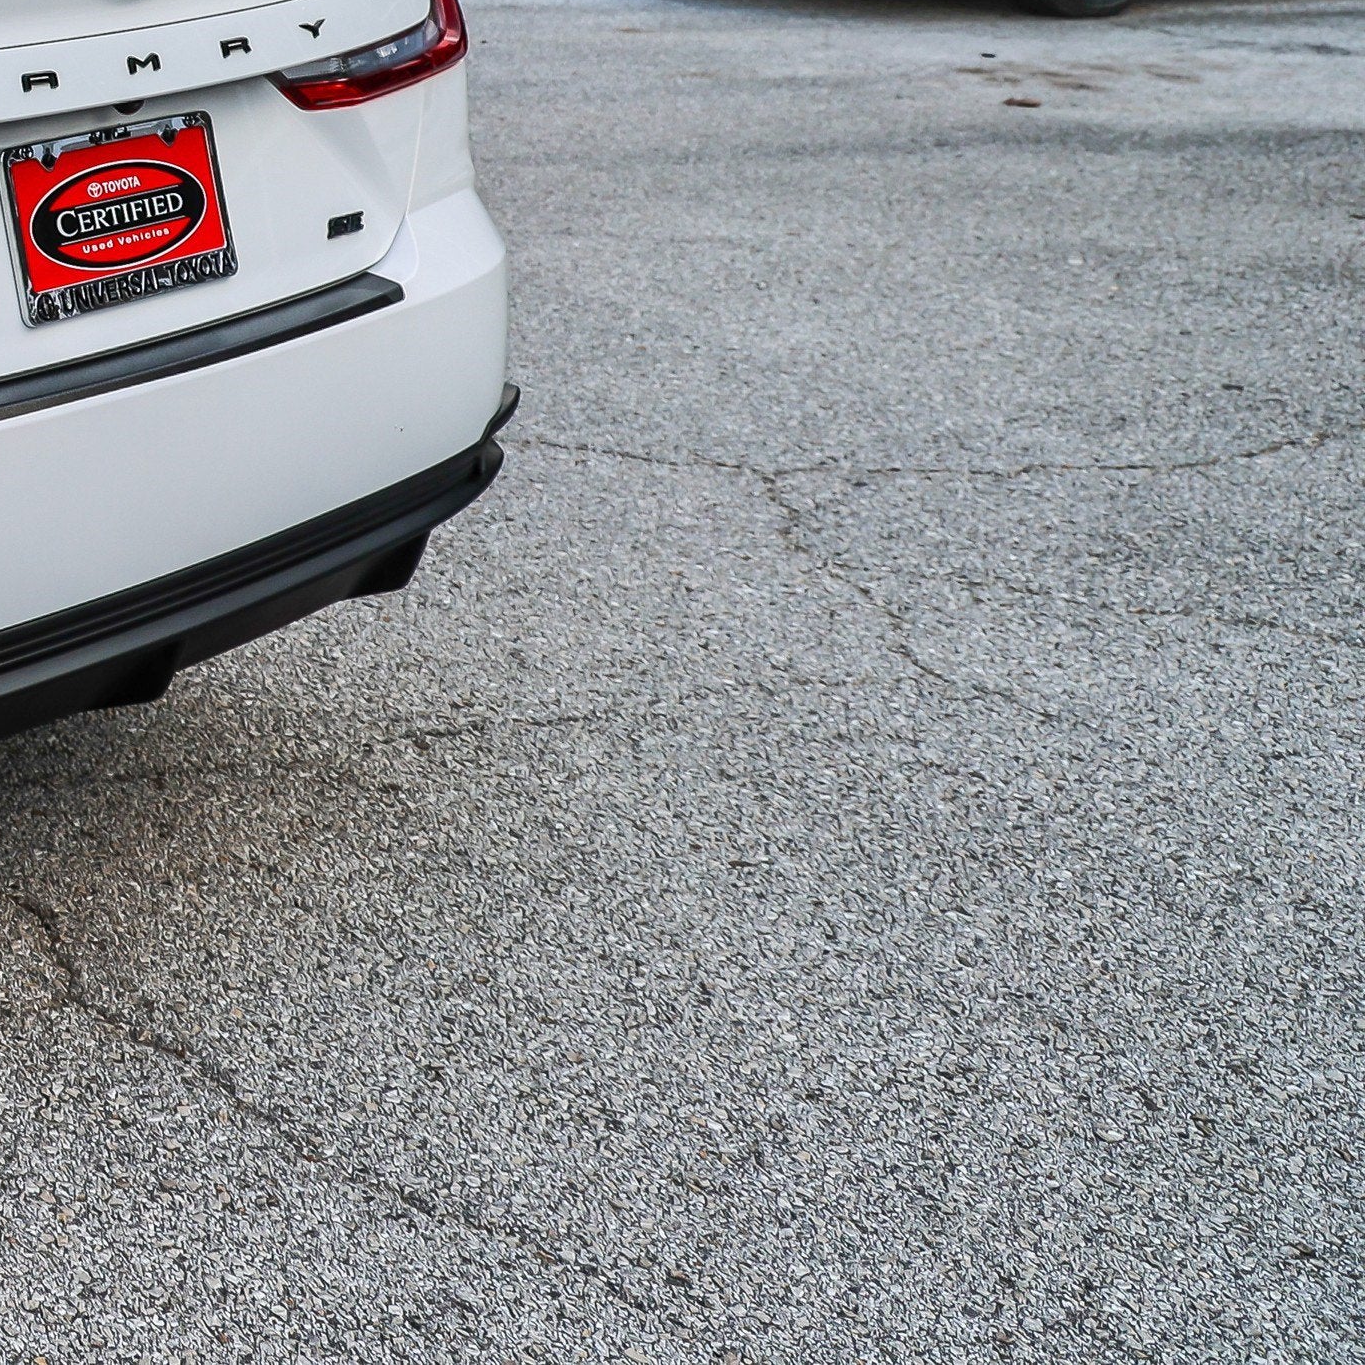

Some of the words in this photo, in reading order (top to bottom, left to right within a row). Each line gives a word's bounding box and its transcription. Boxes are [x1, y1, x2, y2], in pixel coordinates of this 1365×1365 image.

[102, 176, 141, 193] TOYOTA
[56, 192, 183, 237] CERTIFIED
[81, 240, 114, 254] Used
[117, 227, 170, 247] Vehicles
[63, 268, 166, 312] UNIVERSAL
[167, 251, 233, 283] TOYOTA
